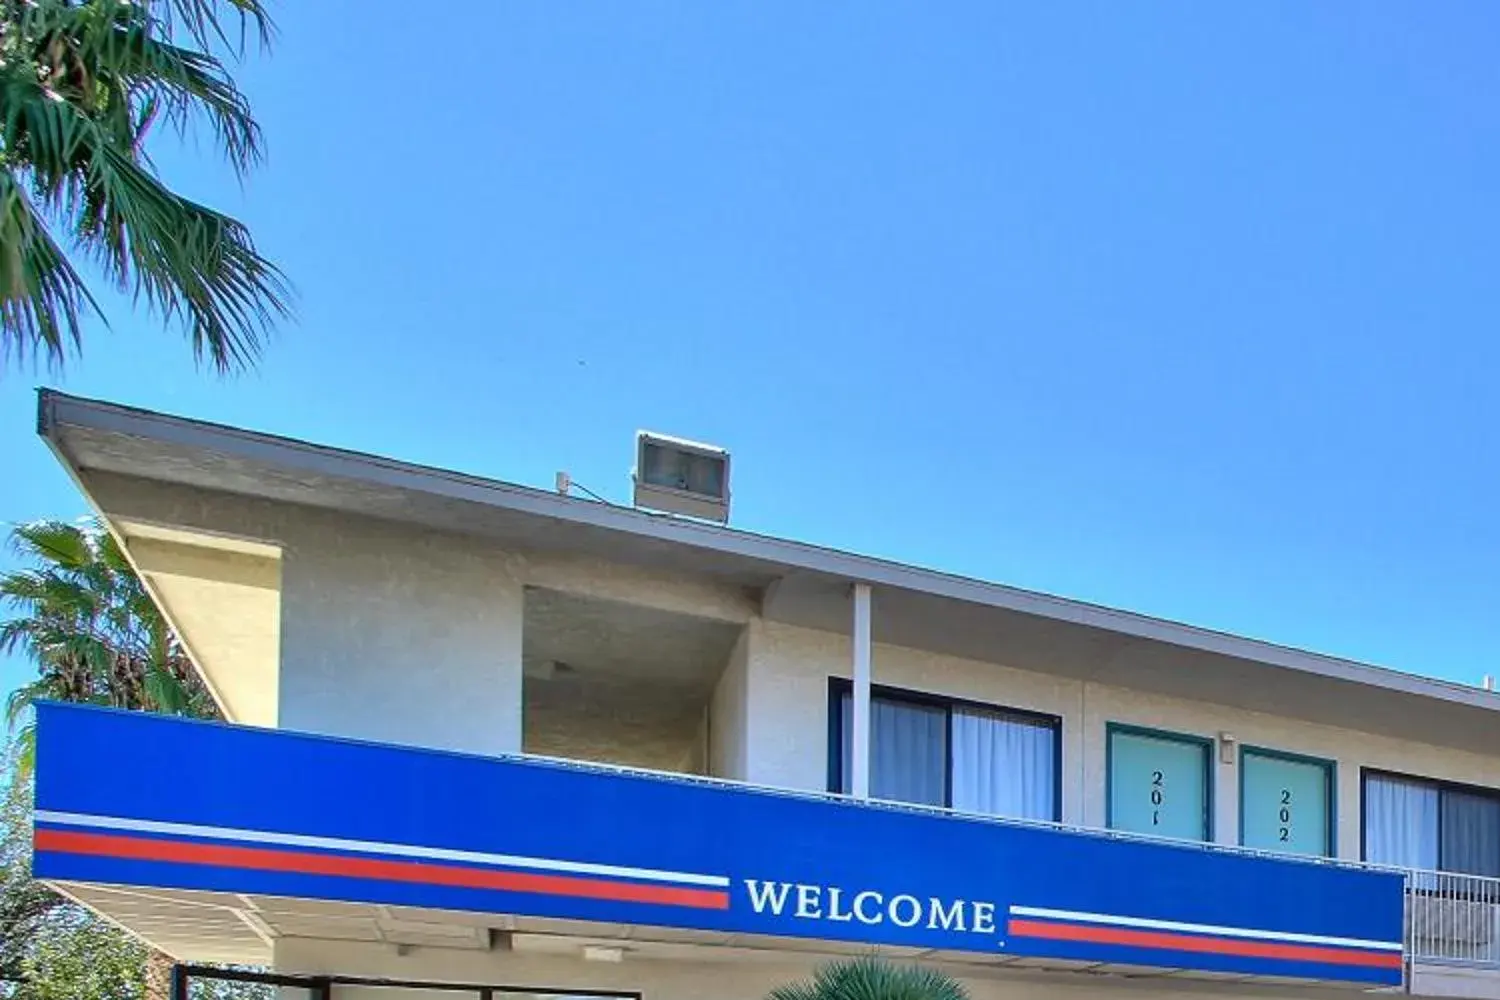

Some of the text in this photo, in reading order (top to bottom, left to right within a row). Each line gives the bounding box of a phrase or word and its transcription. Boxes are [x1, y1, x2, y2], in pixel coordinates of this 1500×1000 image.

[1151, 771, 1164, 826] 201
[1279, 790, 1291, 842] 202
[744, 879, 996, 933] WELCOME
